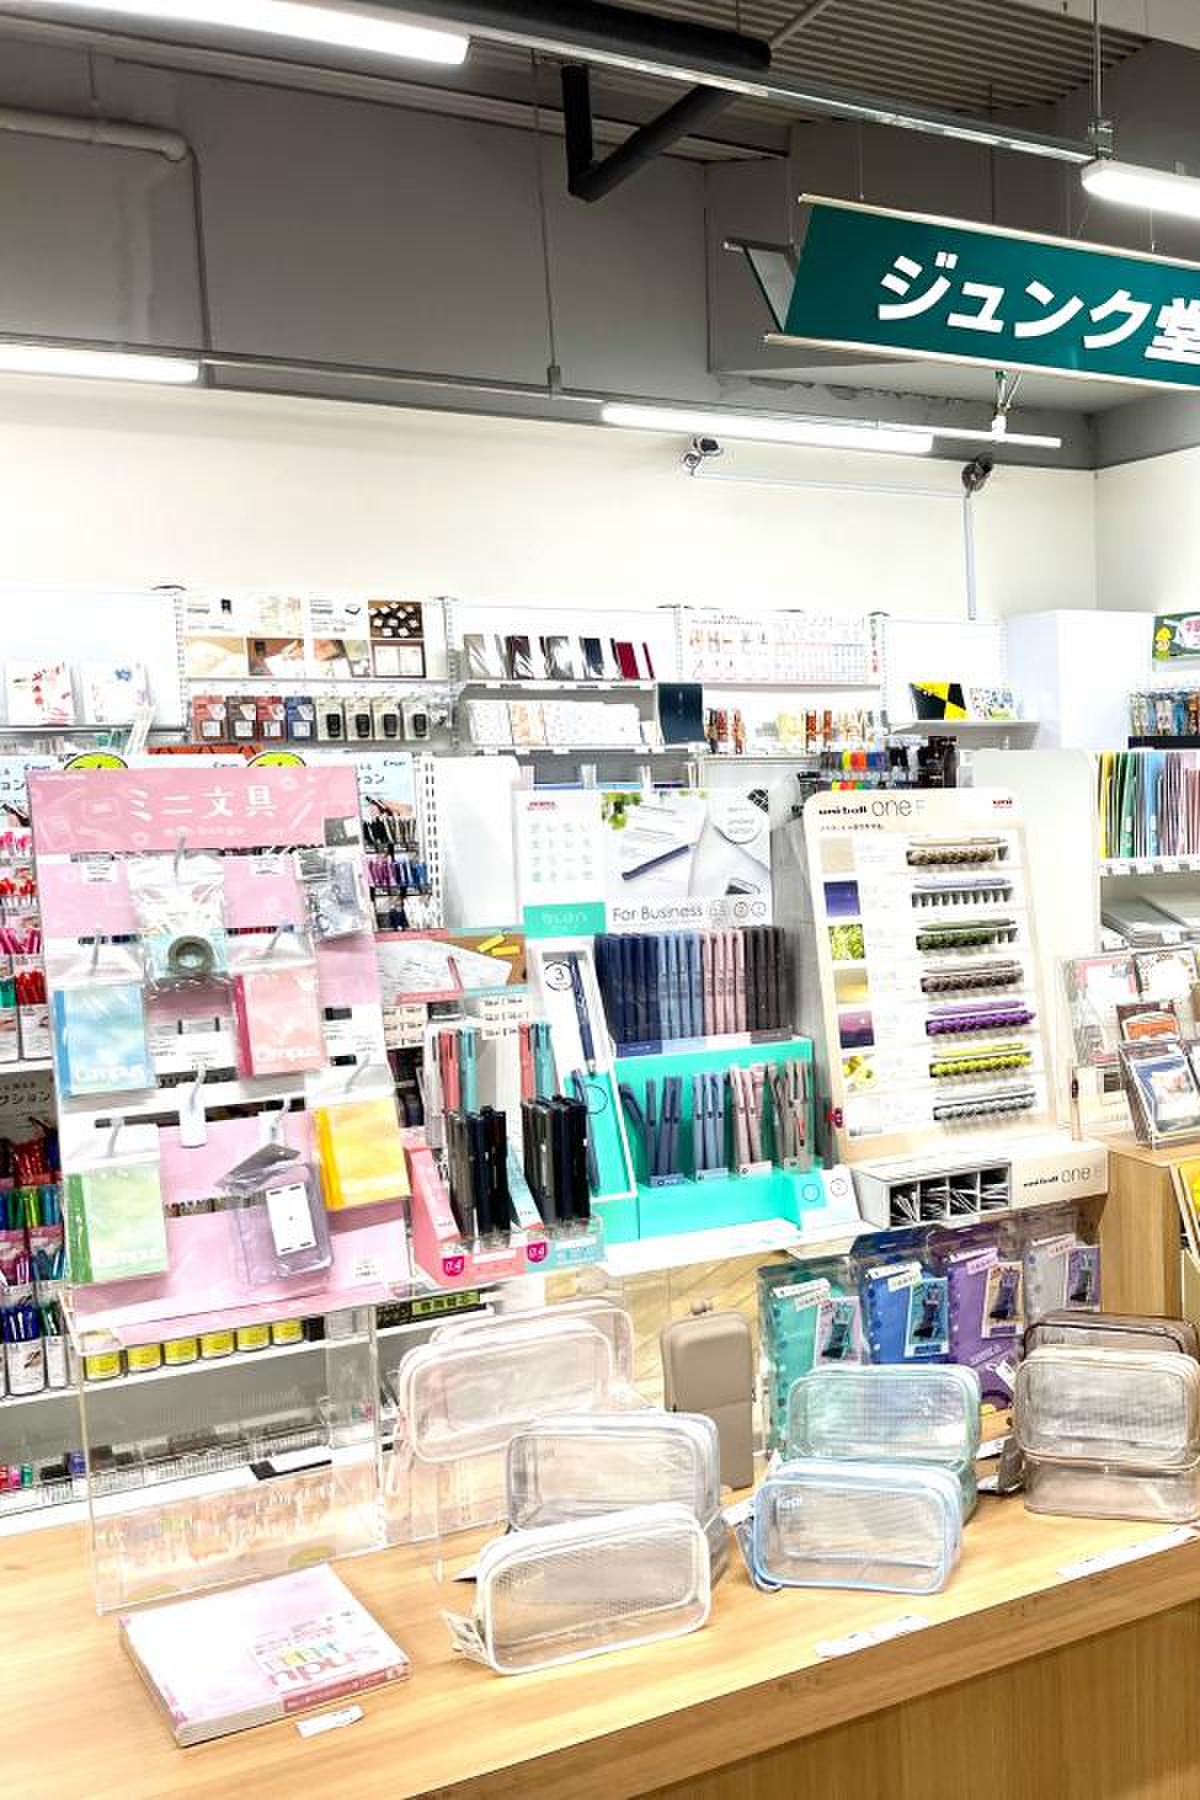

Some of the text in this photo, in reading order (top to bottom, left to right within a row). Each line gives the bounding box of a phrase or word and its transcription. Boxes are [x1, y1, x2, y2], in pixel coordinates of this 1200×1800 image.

[128, 785, 277, 818] ミニ文具
[871, 799, 912, 817] one
[612, 905, 703, 922] For Business
[1061, 1167, 1091, 1184] one
